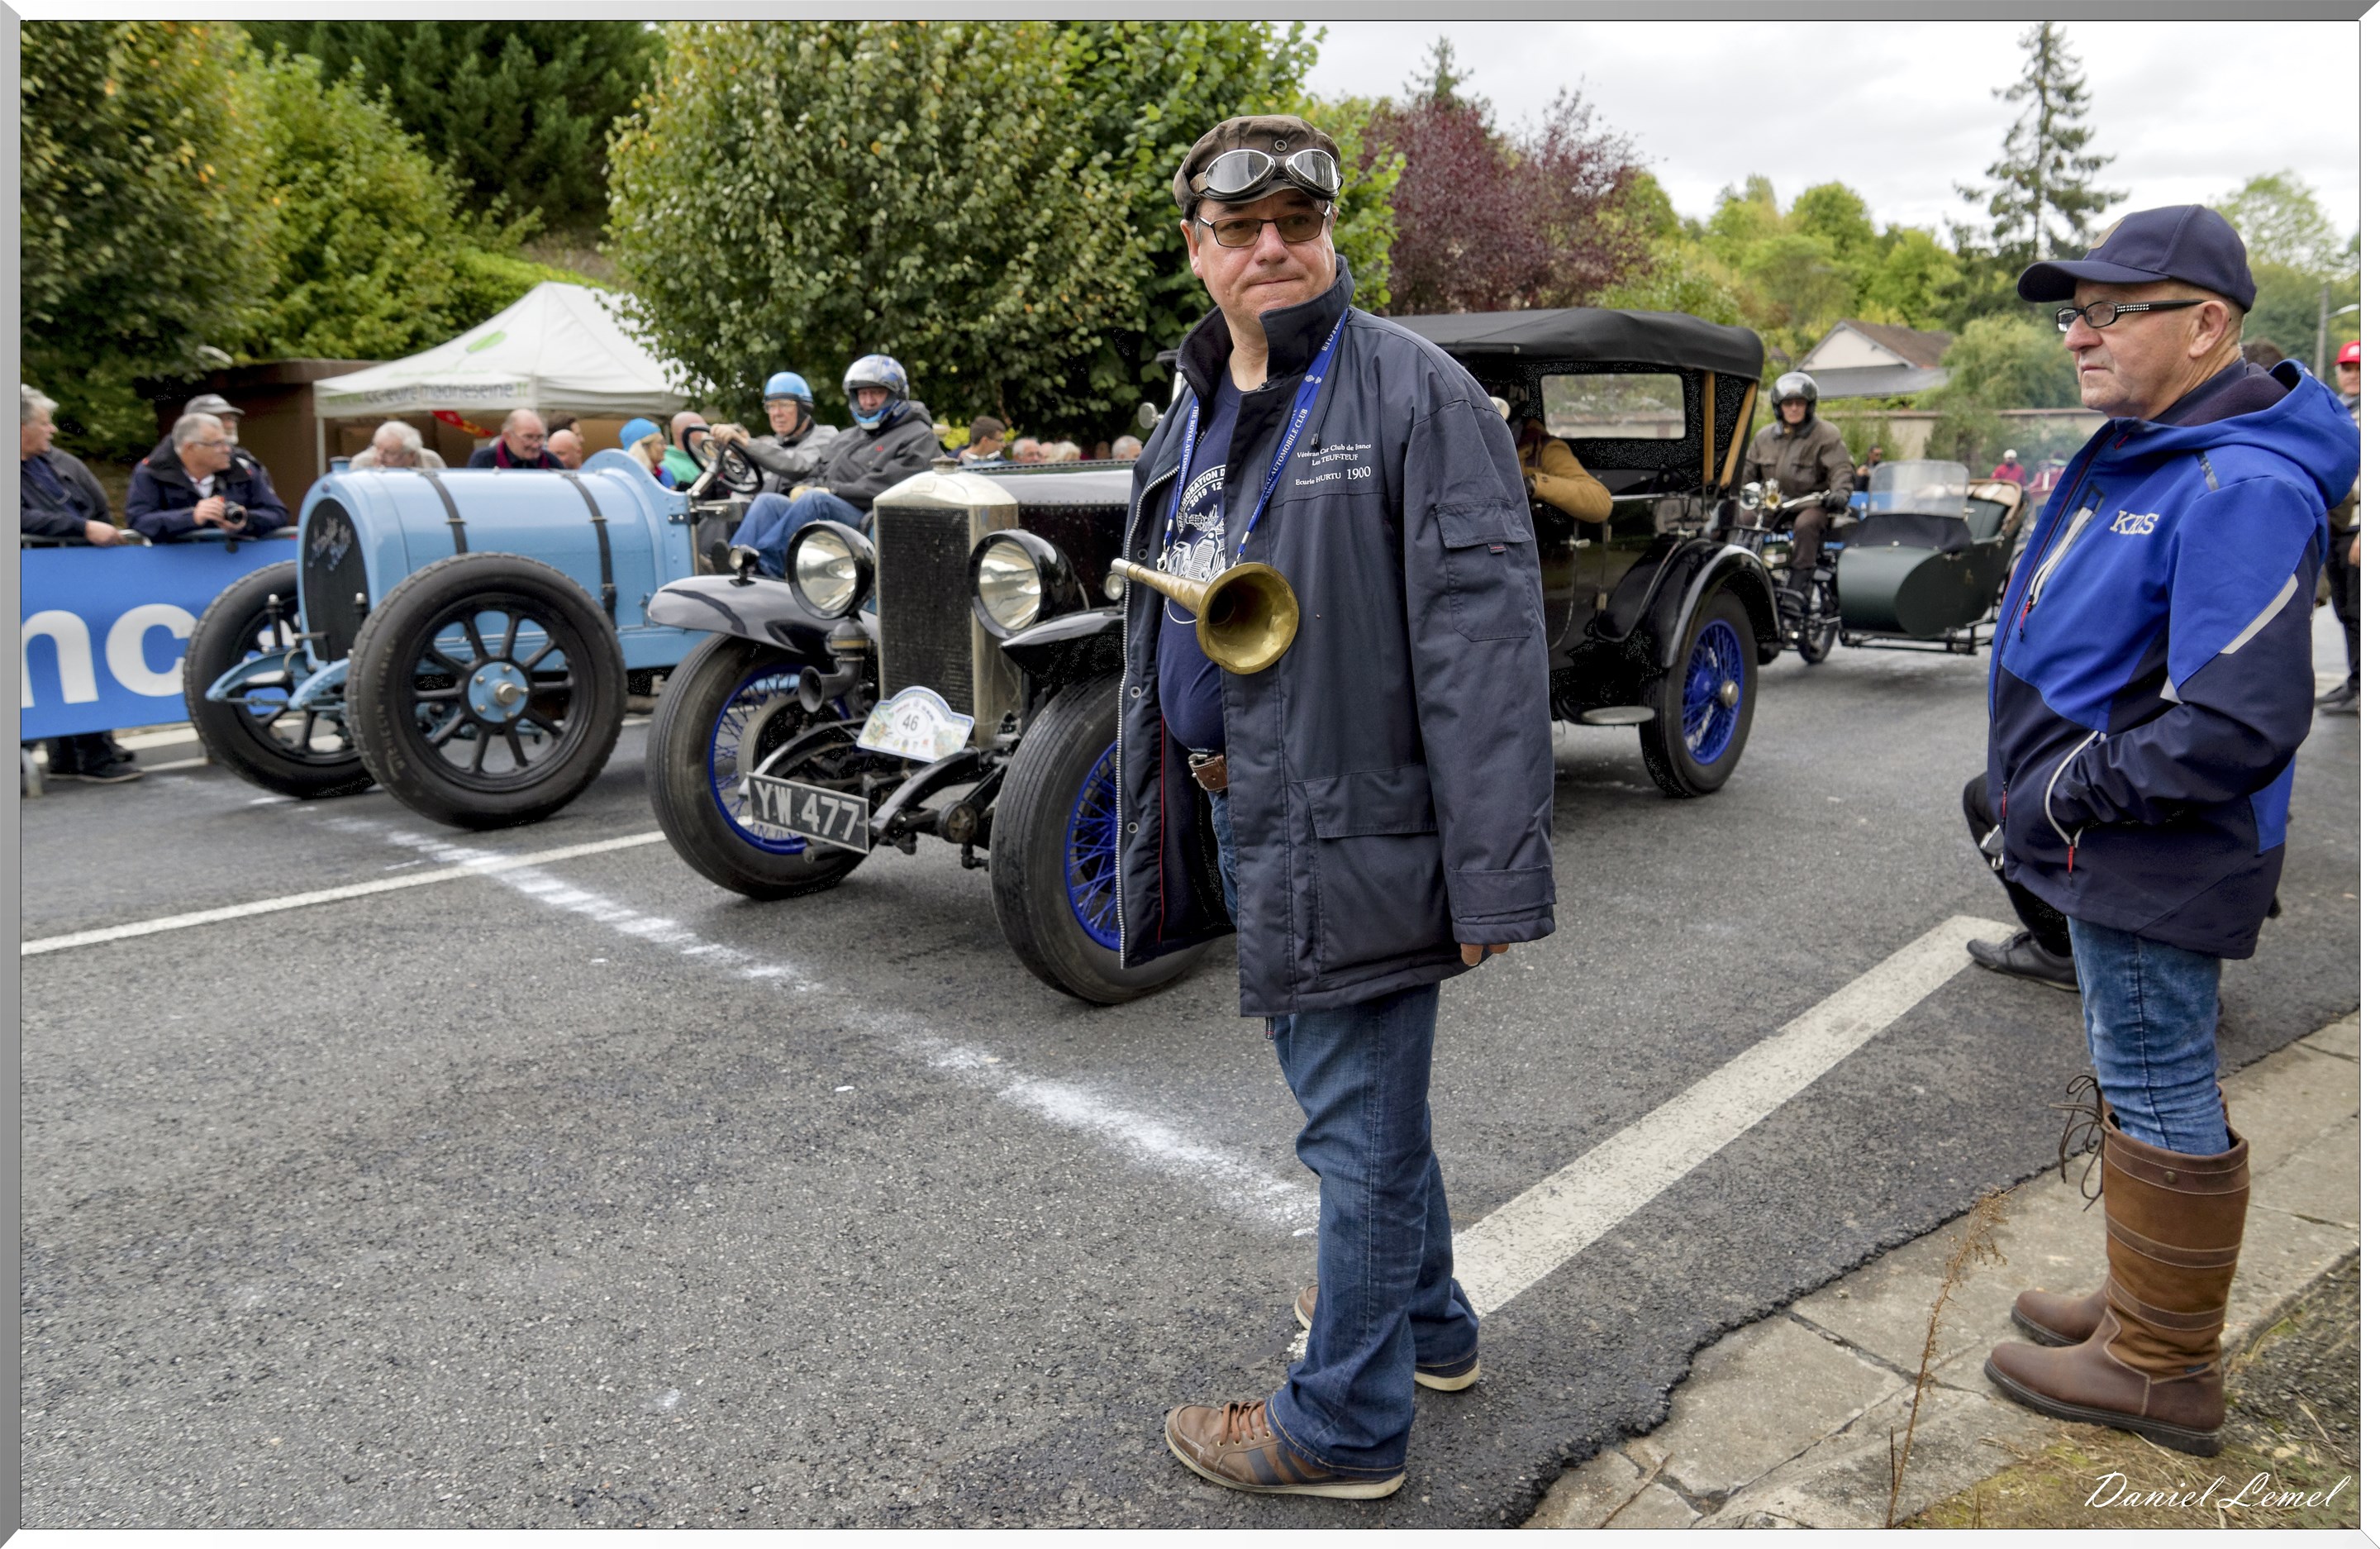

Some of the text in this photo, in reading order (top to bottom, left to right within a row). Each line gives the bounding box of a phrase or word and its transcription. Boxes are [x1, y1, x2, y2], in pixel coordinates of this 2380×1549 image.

[1186, 420, 1195, 444] ROYAL
[1271, 408, 1308, 476] AUTOMOBILE CLUB
[1321, 453, 1358, 463] TEUF-TEUF
[1316, 472, 1341, 483] HURTU
[1346, 466, 1371, 479] 1900
[1190, 488, 1207, 508] 2019
[902, 714, 919, 732] 46
[754, 780, 859, 841] YW 477
